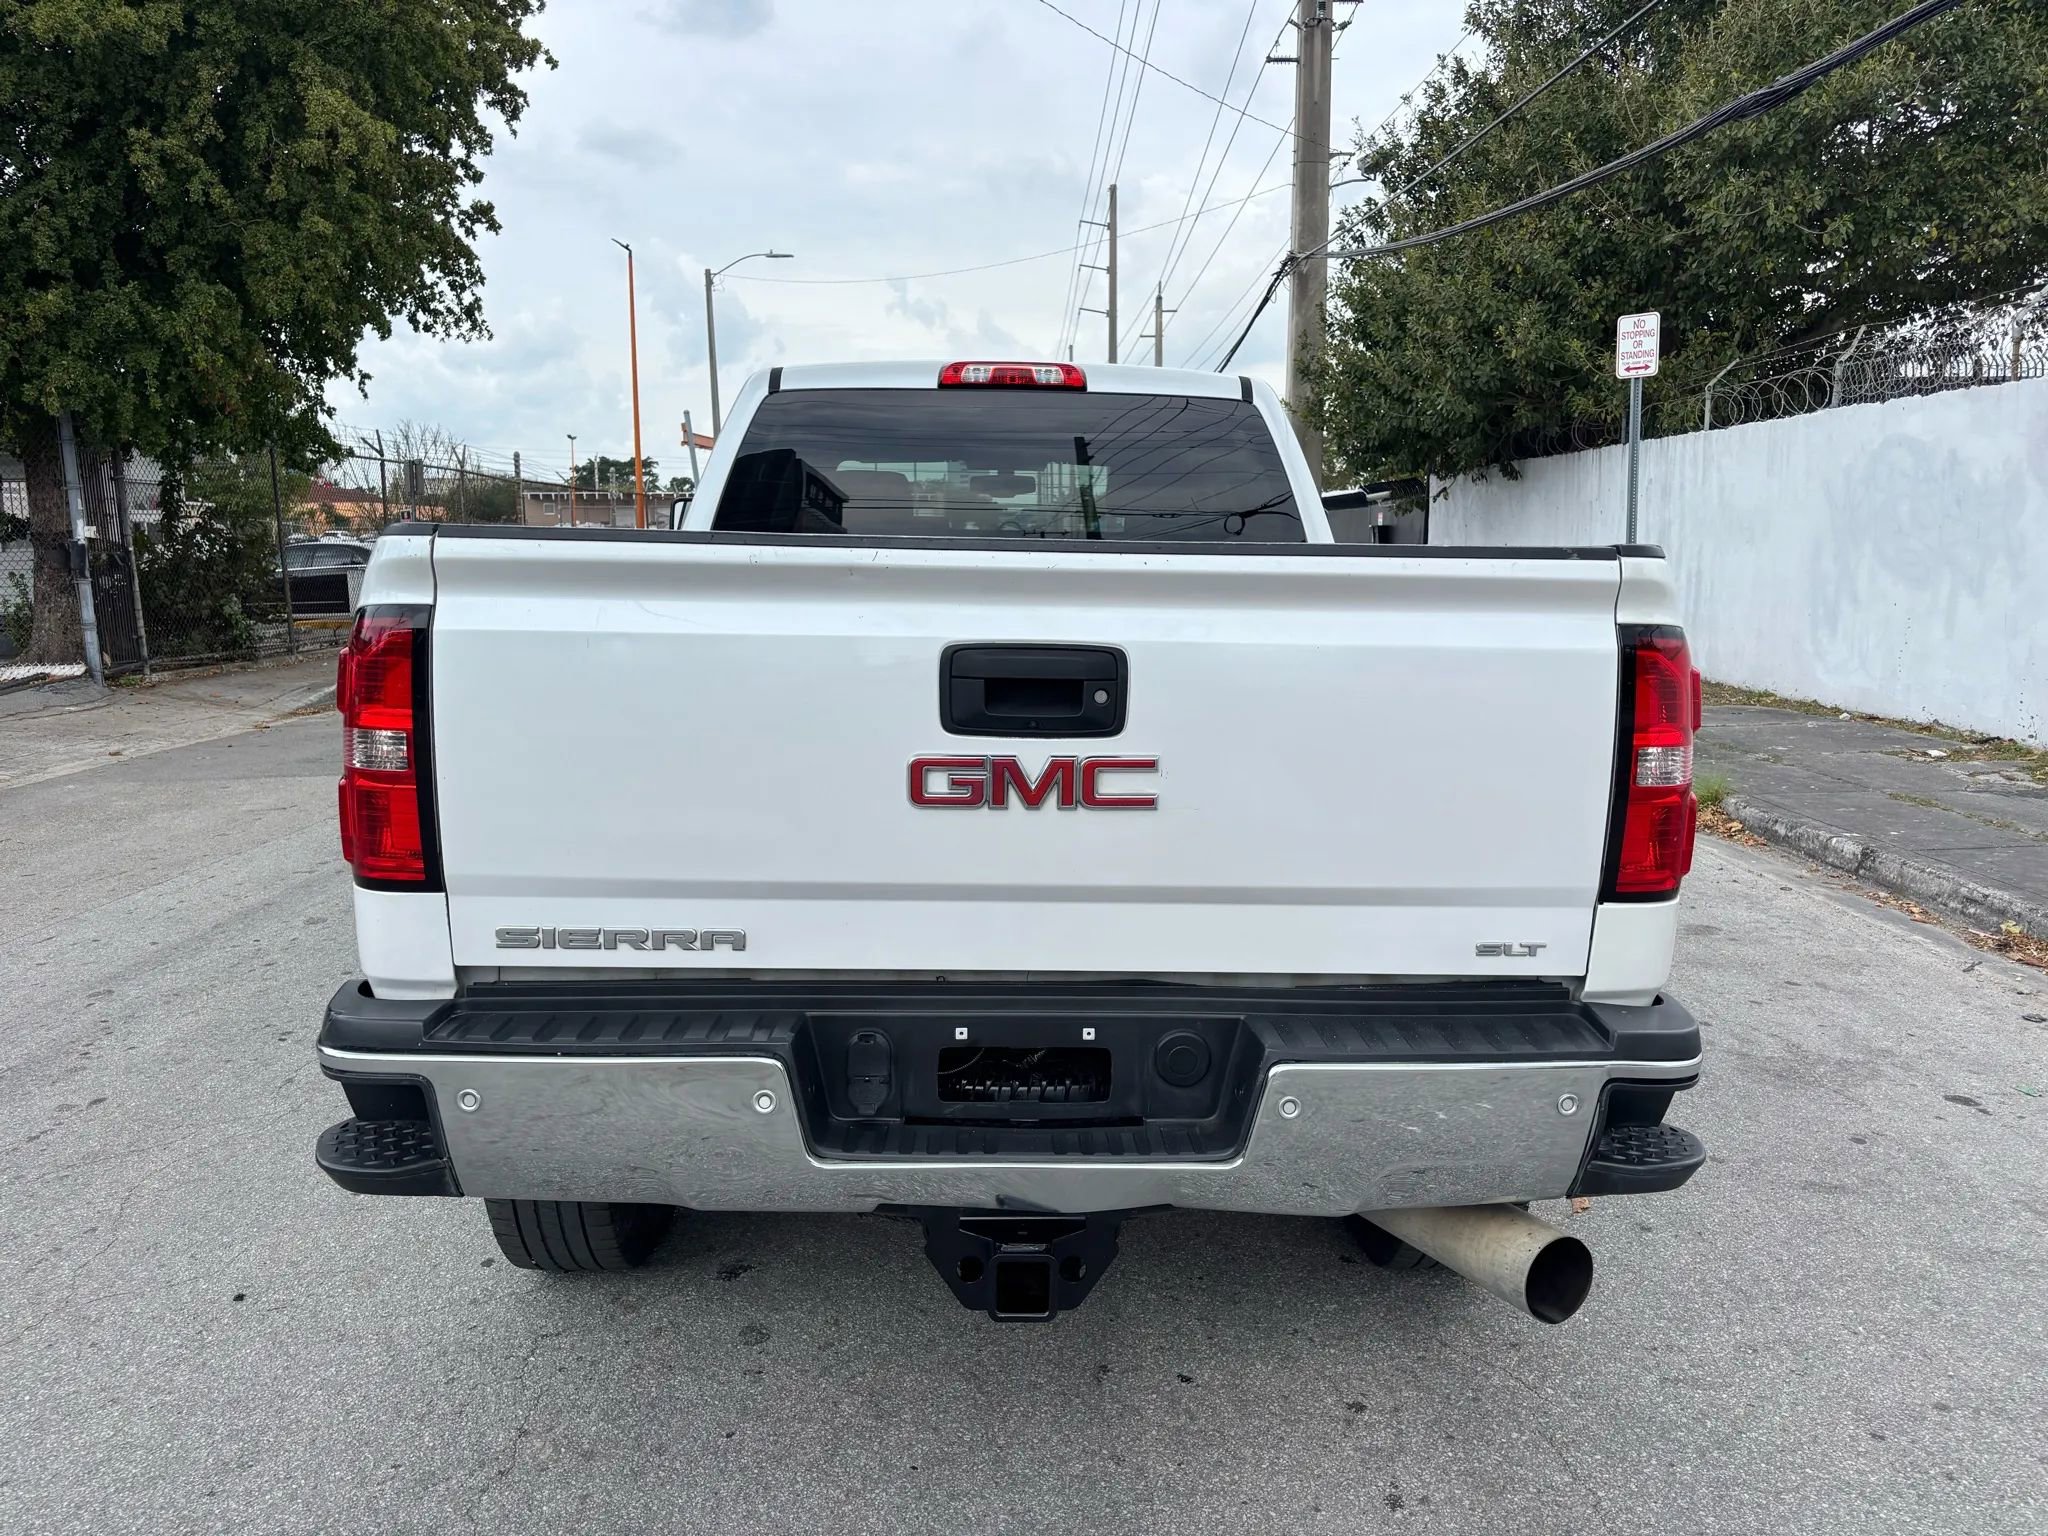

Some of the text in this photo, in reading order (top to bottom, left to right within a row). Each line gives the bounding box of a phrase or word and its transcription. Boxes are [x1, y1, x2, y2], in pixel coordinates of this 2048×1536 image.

[1633, 319, 1646, 329] NO
[1621, 328, 1655, 340] STOPPING
[1632, 340, 1643, 349] OR
[1620, 349, 1654, 360] STANDING
[908, 755, 1159, 810] GMC
[495, 926, 746, 951] SIERRA
[1475, 942, 1547, 957] SLT
